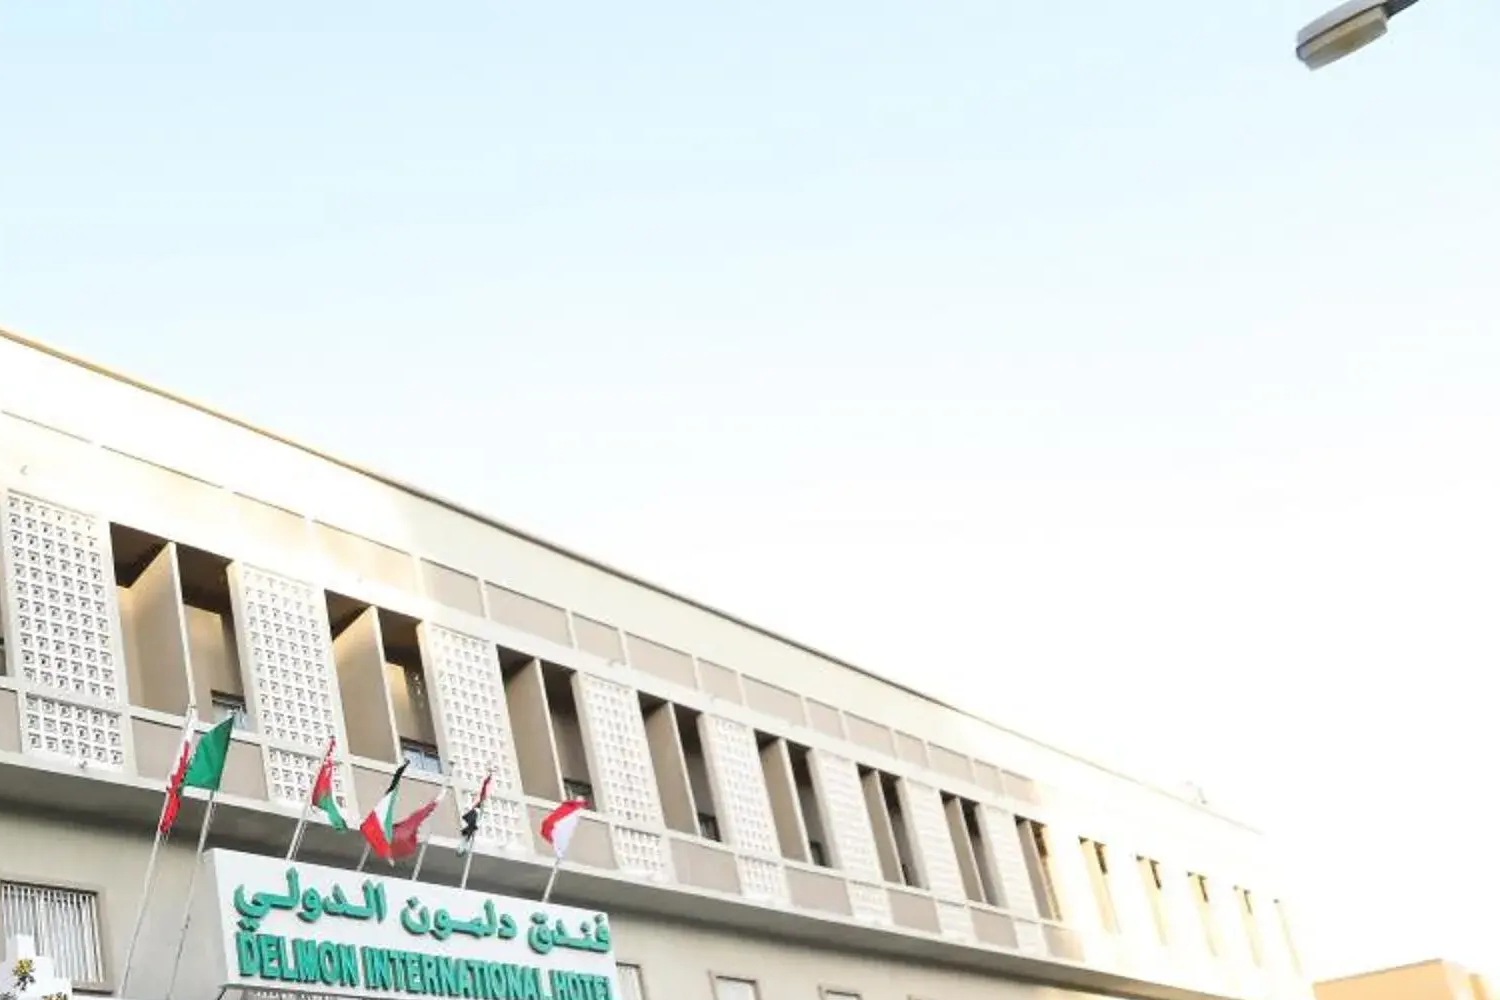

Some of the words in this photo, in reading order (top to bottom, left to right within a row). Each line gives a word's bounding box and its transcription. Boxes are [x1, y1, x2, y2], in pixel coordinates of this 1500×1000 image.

[234, 866, 387, 931] الدولي
[401, 896, 517, 940] دلمون
[528, 912, 611, 955] فندق
[235, 932, 360, 988] DELMON
